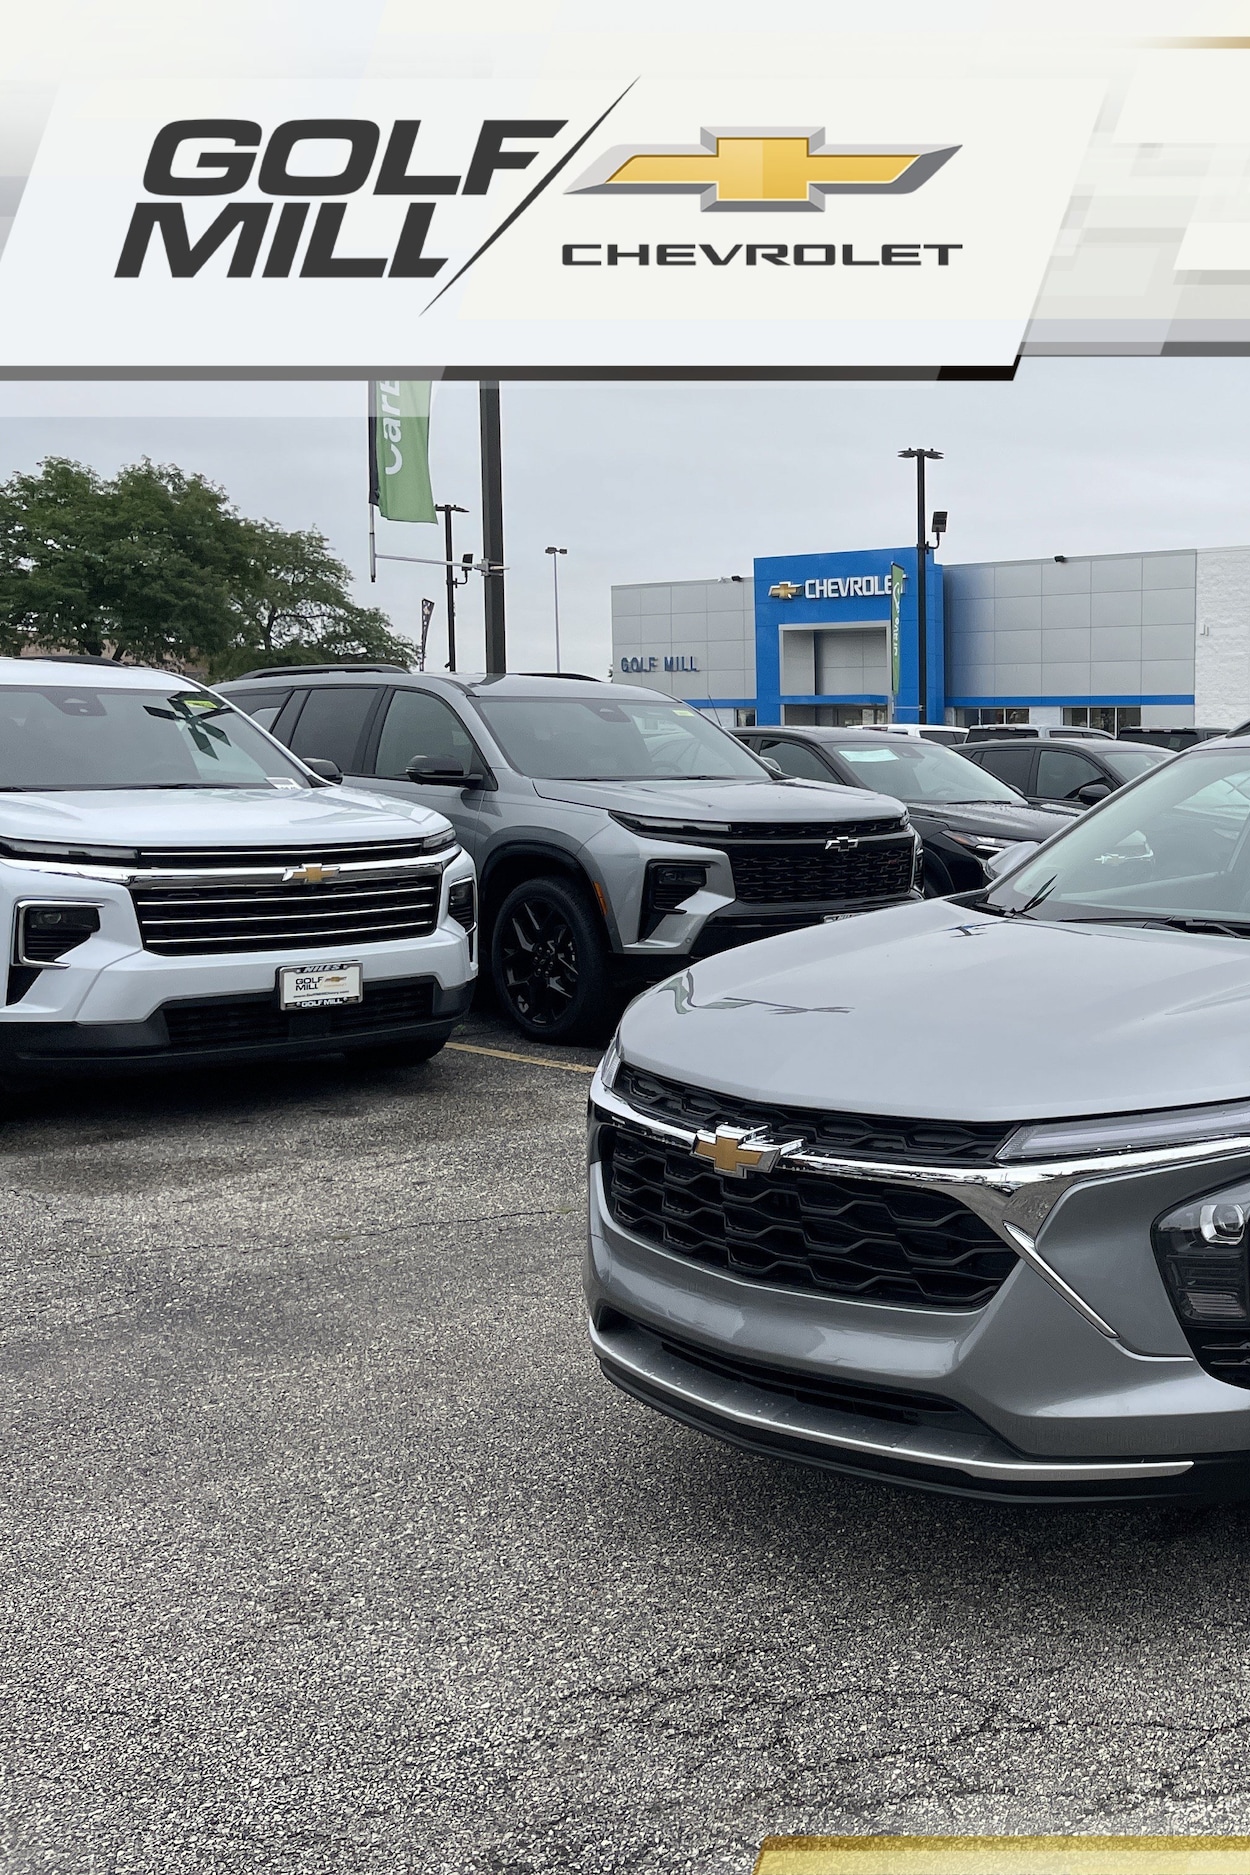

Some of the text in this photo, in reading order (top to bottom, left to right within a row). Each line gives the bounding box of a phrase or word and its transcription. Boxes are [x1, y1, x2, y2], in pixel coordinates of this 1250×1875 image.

[621, 656, 698, 673] GOLF MILL
[303, 964, 341, 973] NILES
[295, 976, 324, 985] GOLF
[295, 983, 318, 991] MILL
[301, 998, 343, 1008] GOLF MILL
